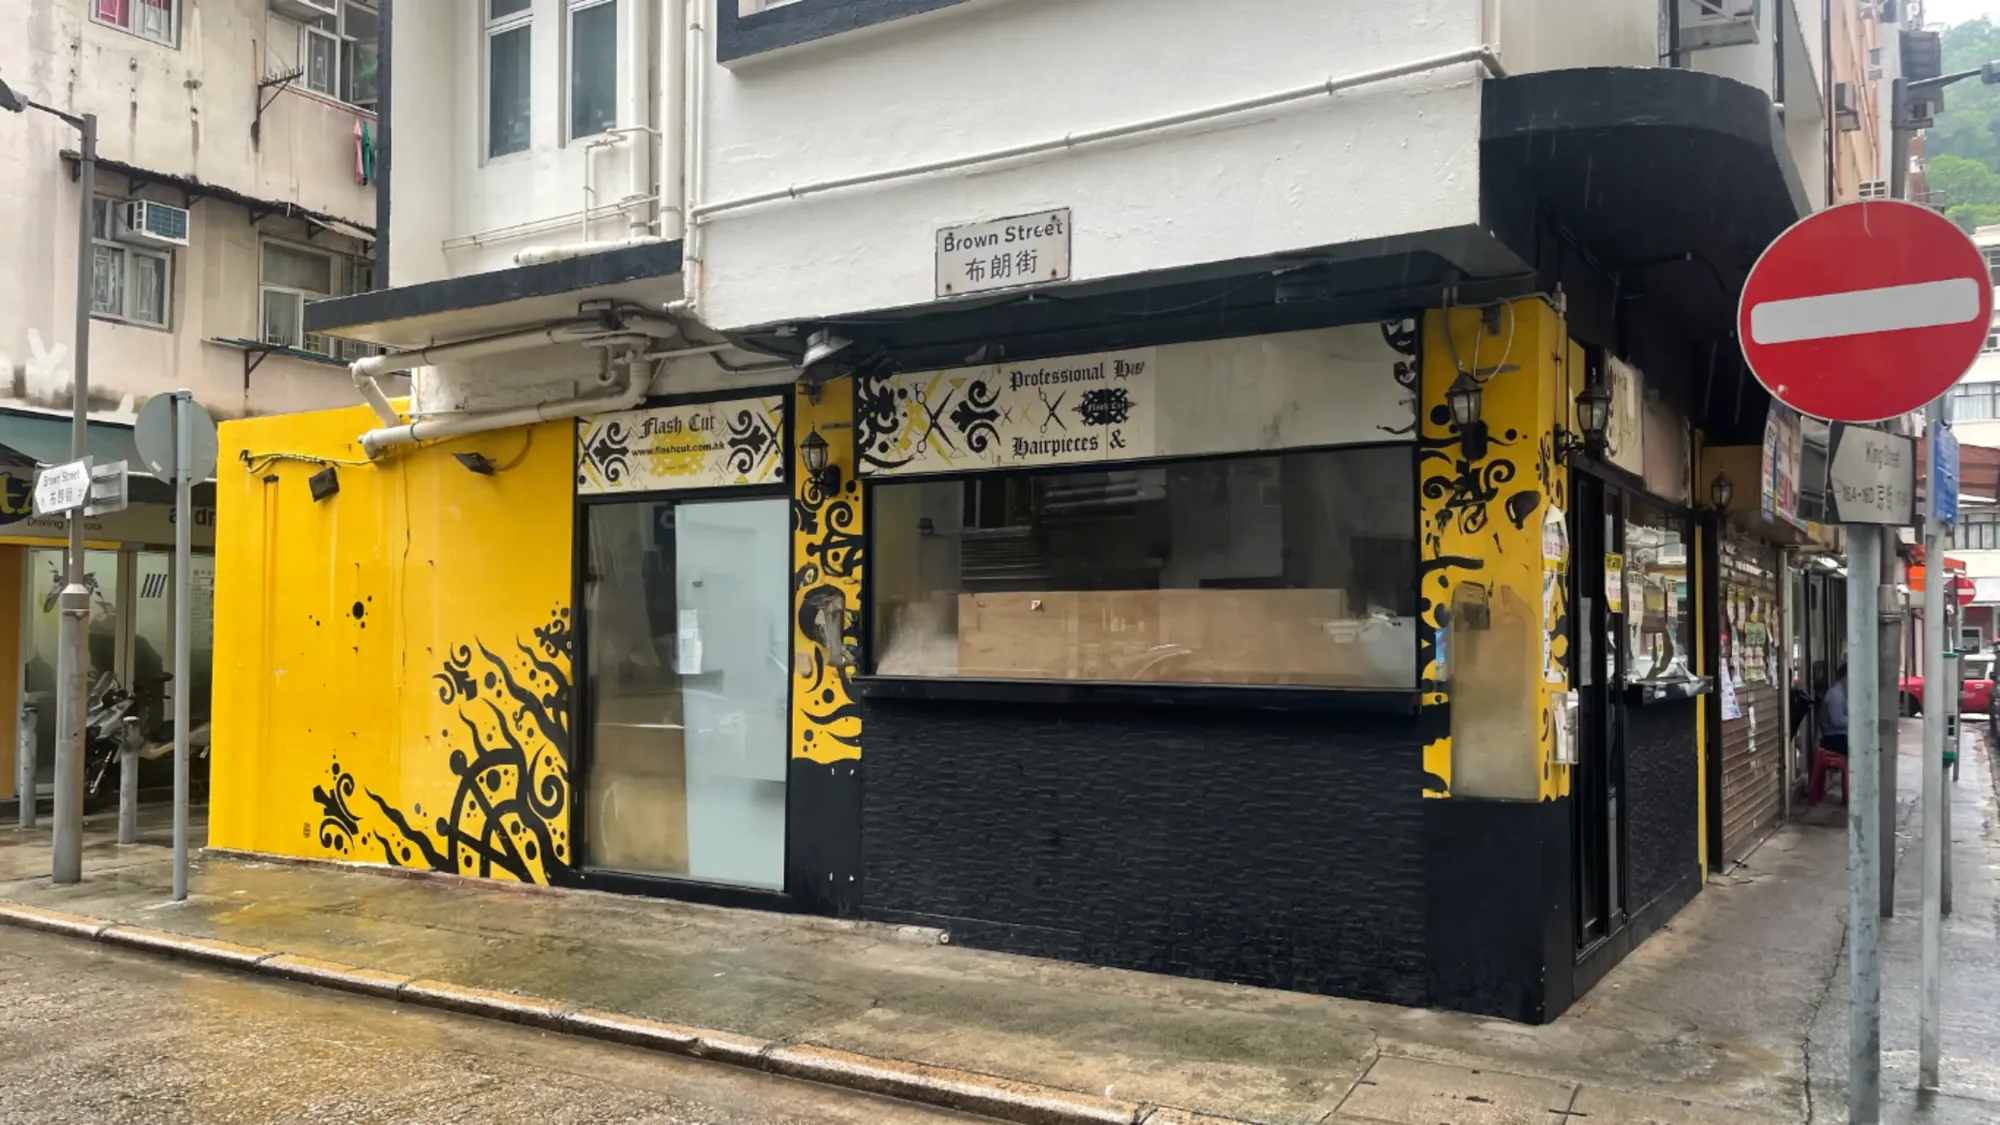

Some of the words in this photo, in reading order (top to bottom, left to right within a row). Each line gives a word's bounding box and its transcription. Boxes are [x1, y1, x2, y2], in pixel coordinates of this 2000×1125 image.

[944, 233, 999, 253] Brown
[1004, 218, 1063, 243] Street
[965, 248, 1039, 282] 布朗街
[1009, 363, 1105, 391] Professional
[638, 416, 682, 439] Flash
[688, 413, 715, 432] Cut
[631, 441, 725, 457] www.flashcut.com.hk
[1012, 435, 1099, 460] Hairpieces
[1109, 429, 1126, 449] &
